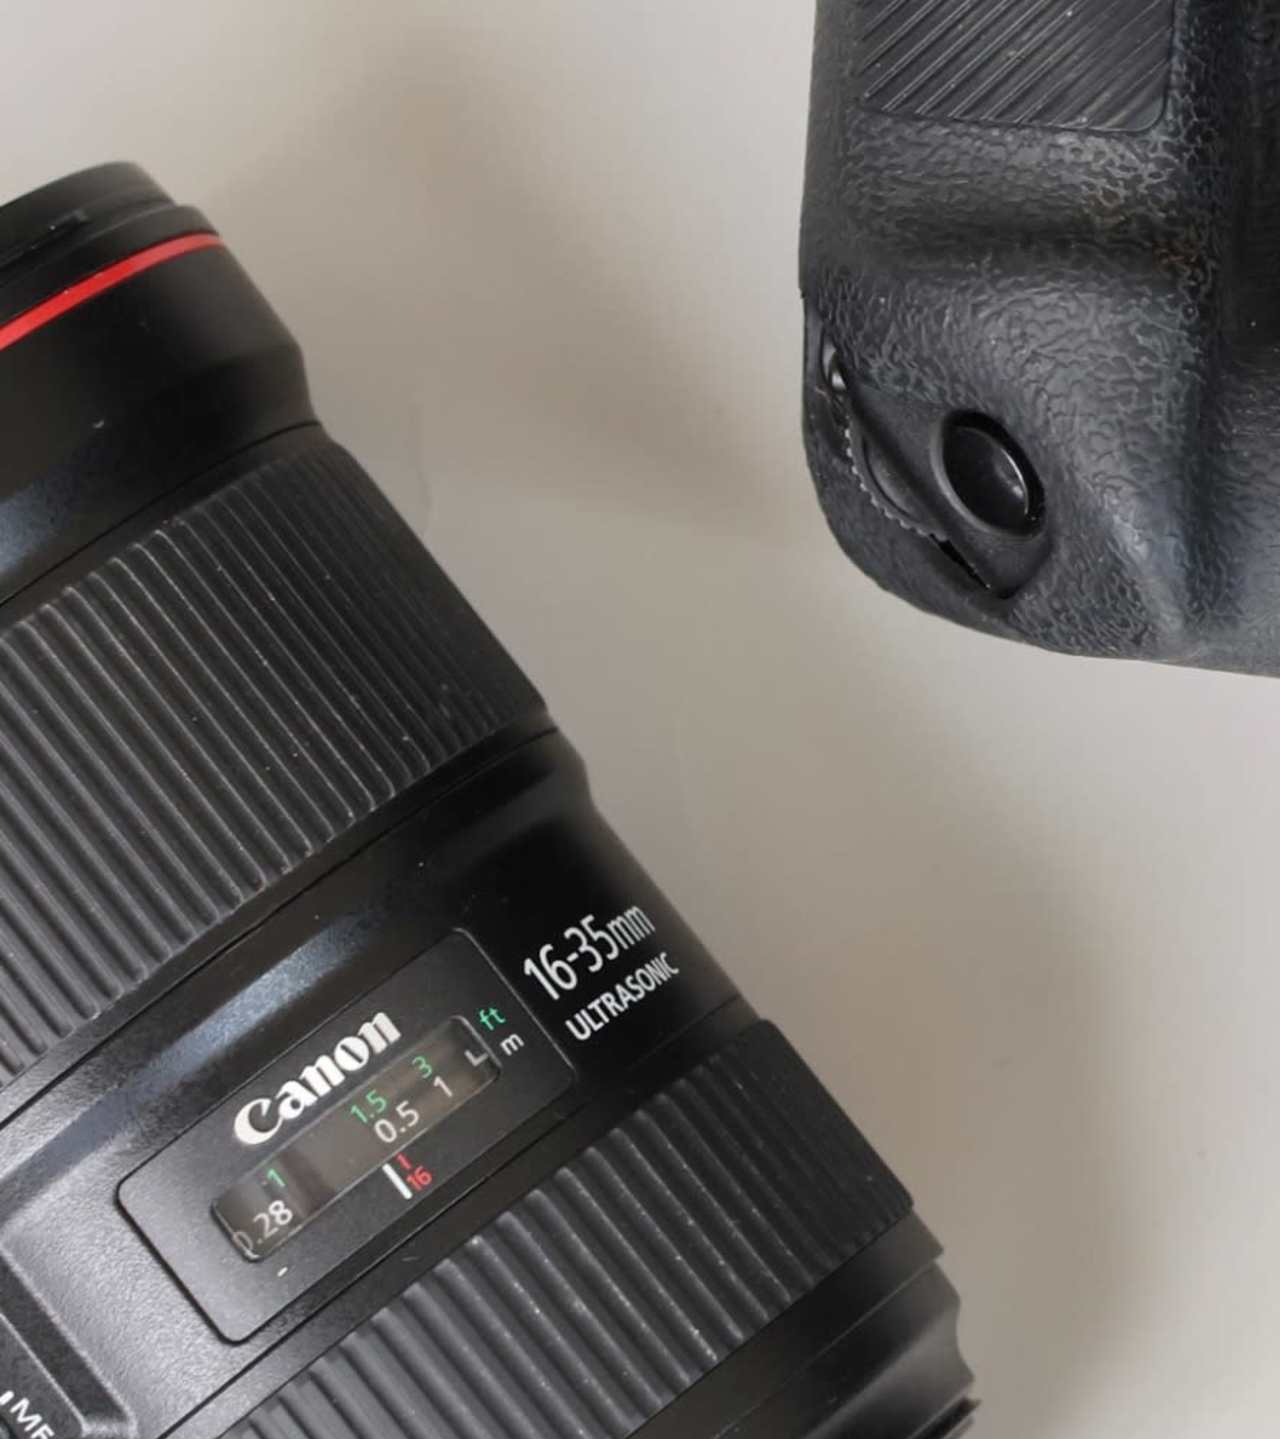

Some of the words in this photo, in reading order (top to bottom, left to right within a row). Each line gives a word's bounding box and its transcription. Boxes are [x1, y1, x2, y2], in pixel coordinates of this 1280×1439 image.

[523, 905, 656, 1000] 16-35mm
[564, 951, 680, 1041] ULTRASONIC
[233, 1012, 402, 1145] Canon
[350, 1089, 388, 1124] 1.5
[411, 1055, 433, 1079] 3
[479, 1006, 506, 1031] ft
[373, 1099, 420, 1143] 0.5
[432, 1075, 453, 1098] 1
[499, 1032, 525, 1057] m
